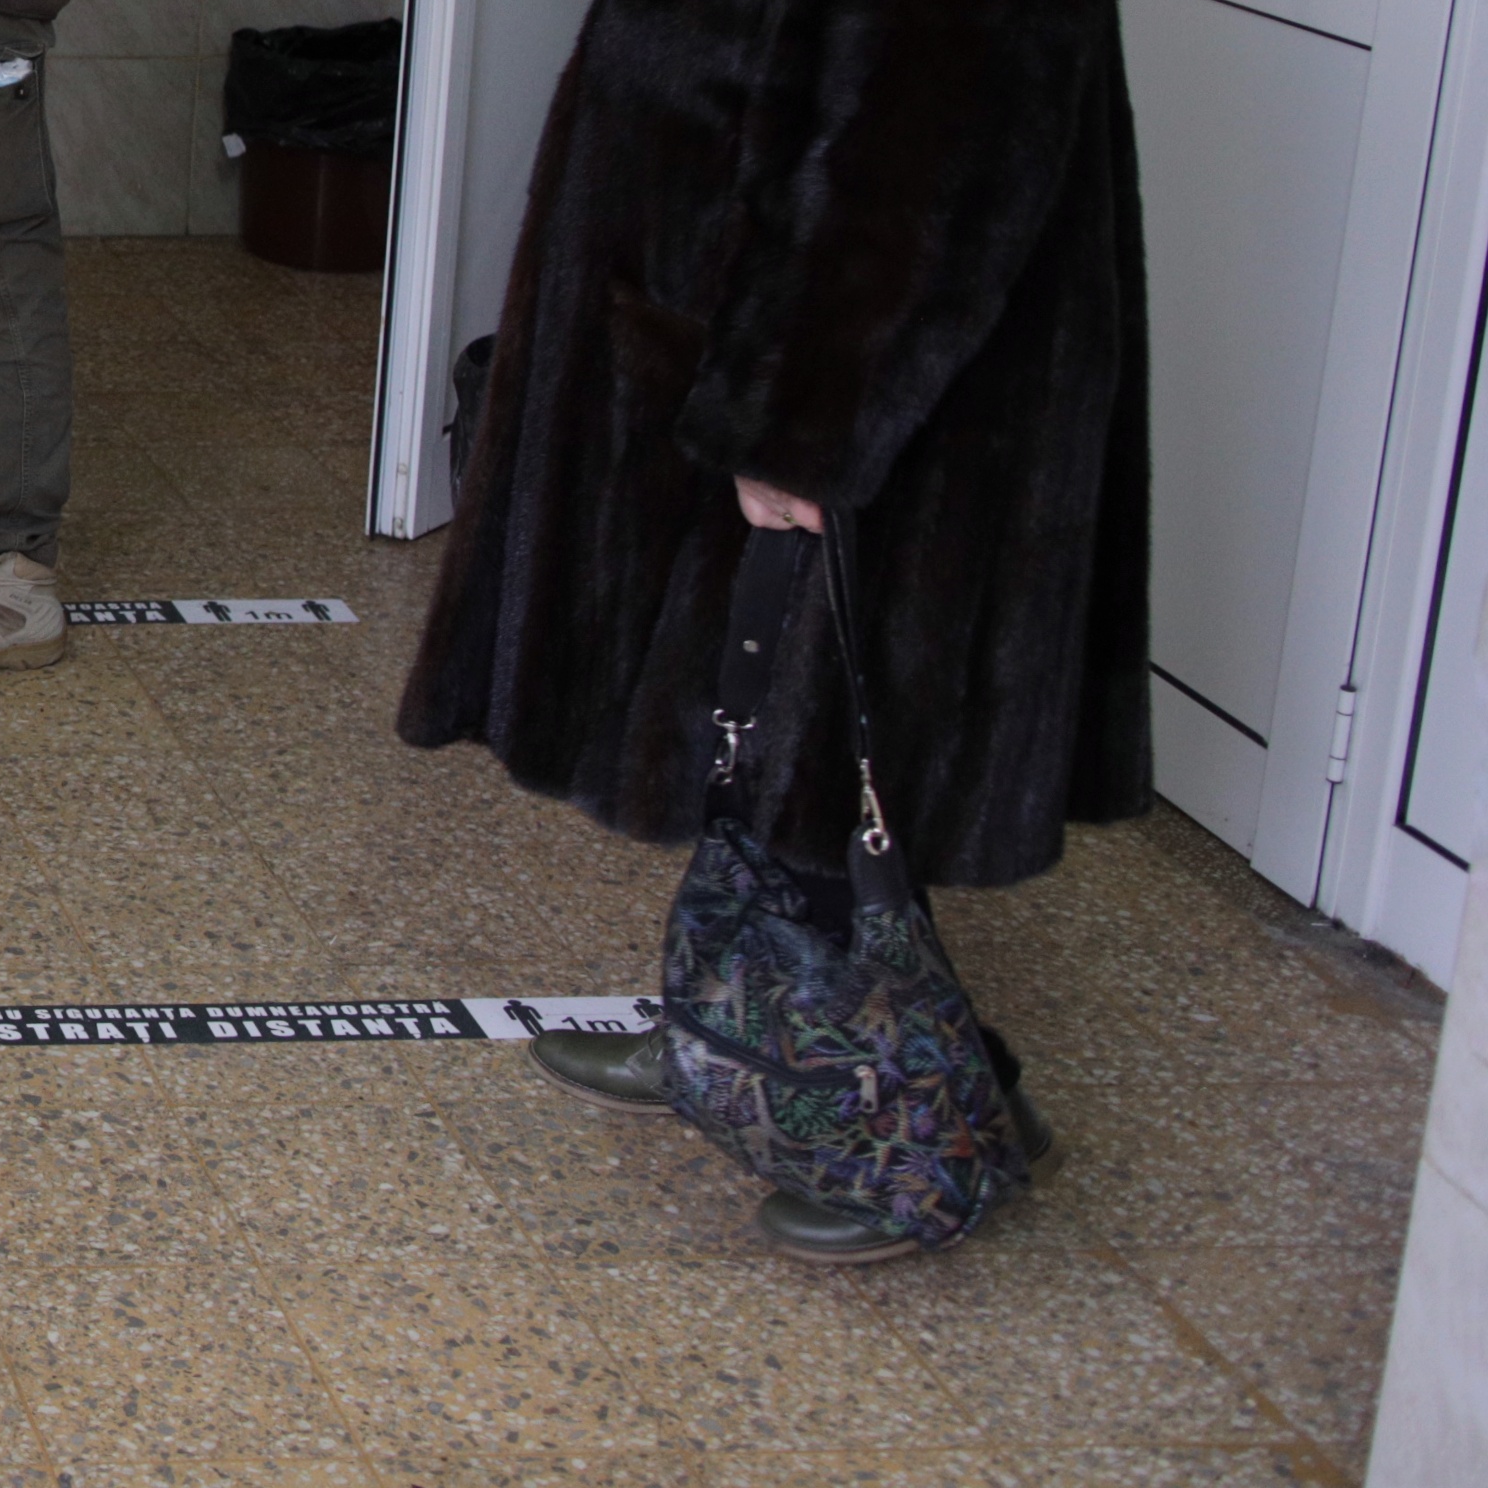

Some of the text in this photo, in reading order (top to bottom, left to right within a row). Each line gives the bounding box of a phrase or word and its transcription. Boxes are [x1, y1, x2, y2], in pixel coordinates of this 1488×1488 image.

[244, 609, 294, 621] 1m
[34, 1007, 197, 1021] SIGURANȚA
[205, 1001, 452, 1018] DUMNEAVOASTRĂ
[206, 1016, 462, 1040] DISTANȚA
